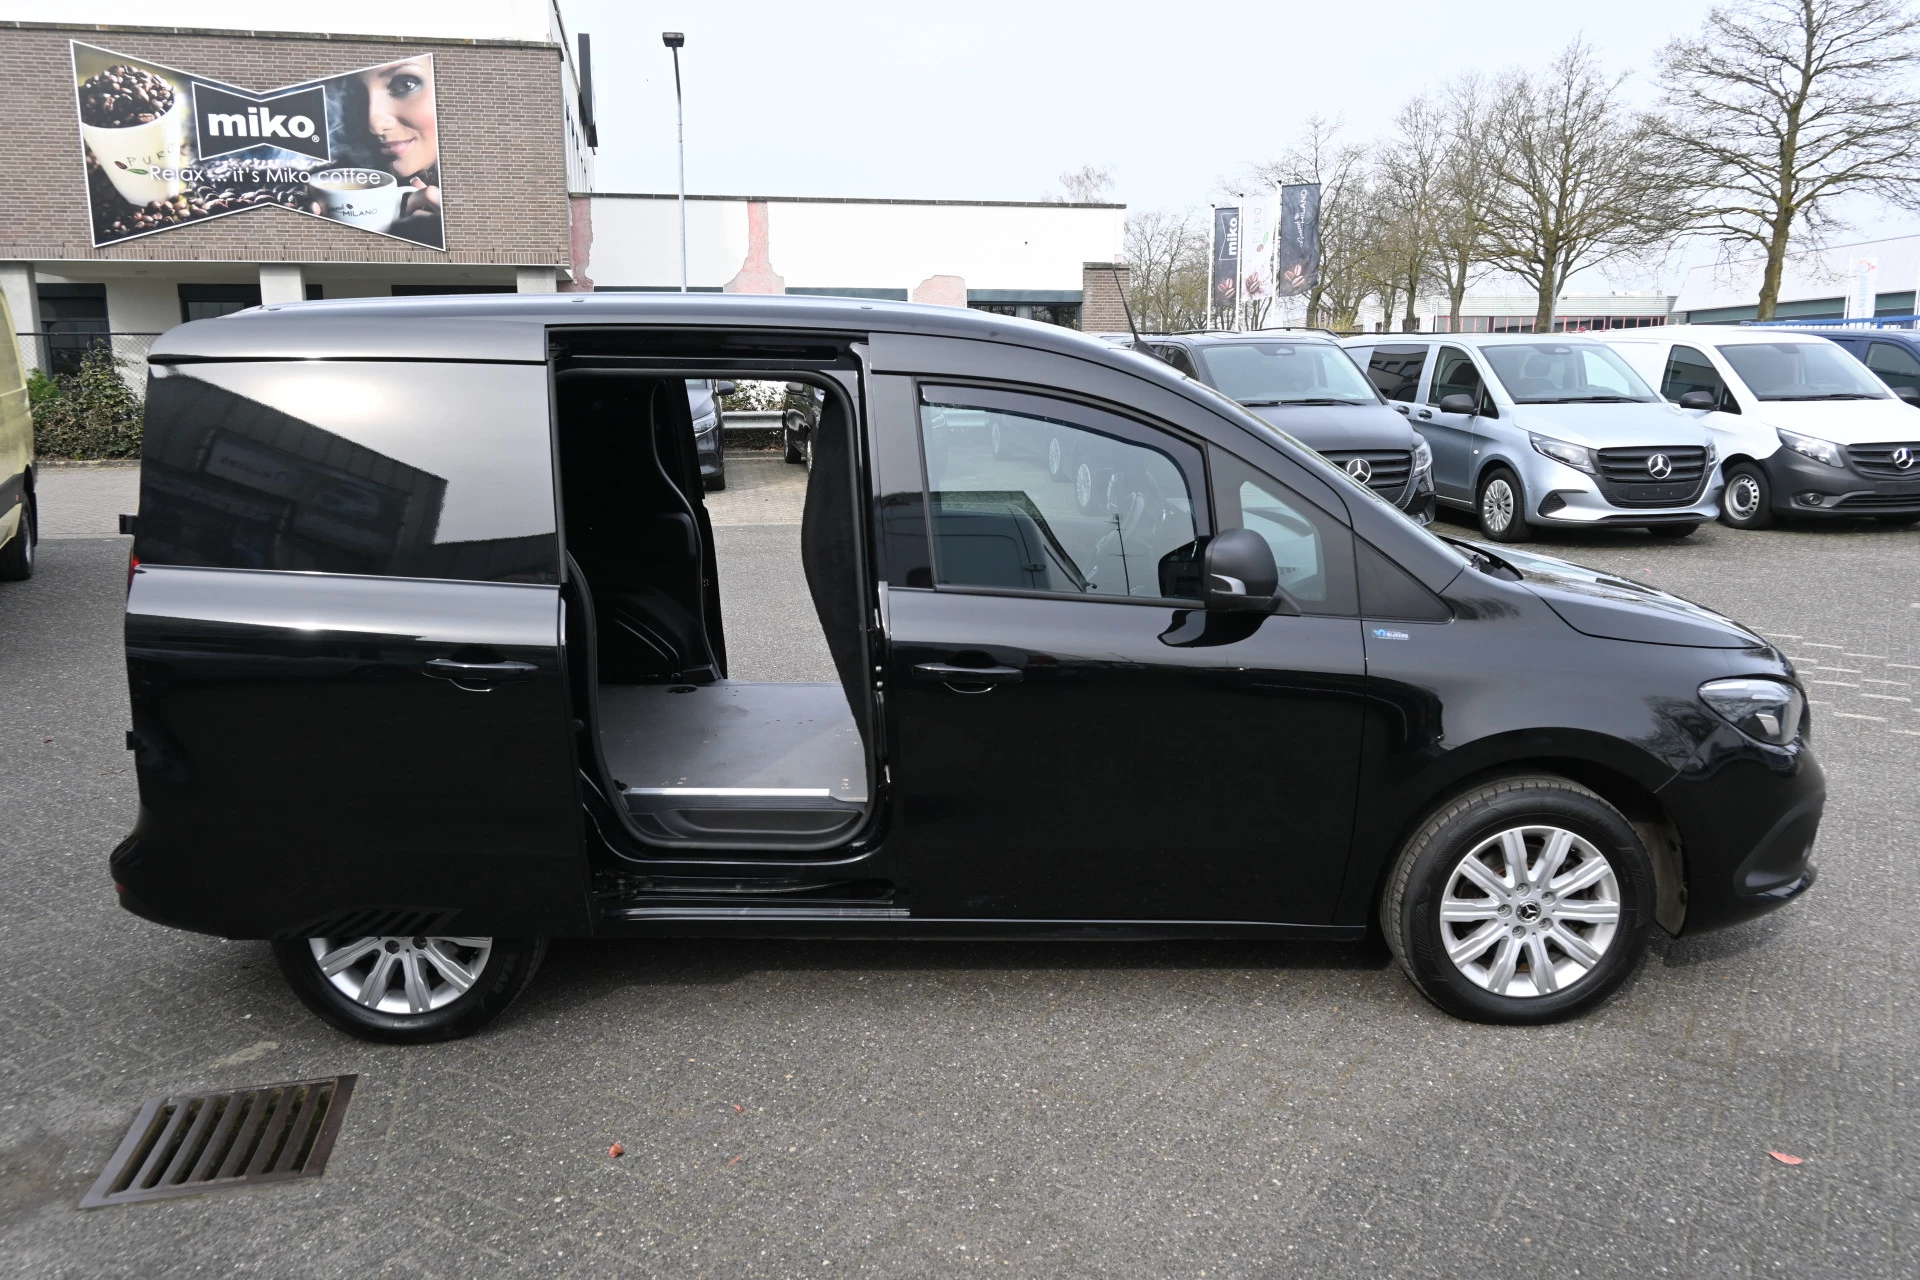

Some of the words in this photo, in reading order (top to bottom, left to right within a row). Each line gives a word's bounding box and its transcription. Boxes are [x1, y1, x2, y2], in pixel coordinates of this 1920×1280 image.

[207, 106, 315, 138] miko
[150, 165, 204, 182] Relax
[232, 167, 260, 183] it's
[266, 168, 311, 184] Miko
[317, 168, 381, 185] coffee
[342, 208, 378, 218] MILANO
[1227, 217, 1238, 256] miko
